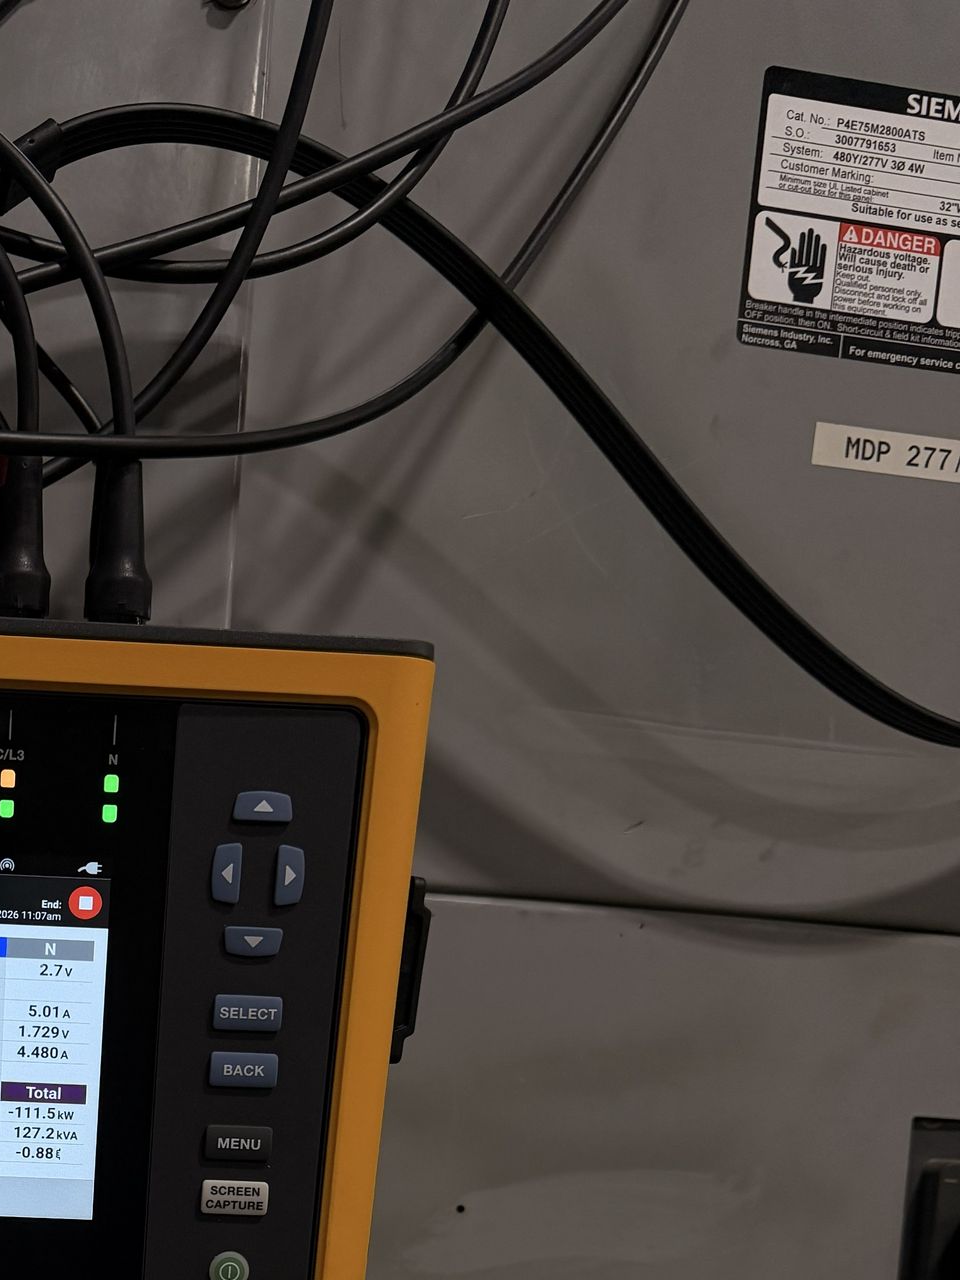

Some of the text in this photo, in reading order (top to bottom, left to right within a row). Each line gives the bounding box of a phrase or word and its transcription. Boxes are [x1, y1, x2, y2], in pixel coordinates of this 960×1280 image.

[786, 109, 807, 123] Cat.
[837, 118, 926, 141] P4E75M2800ATS
[835, 134, 896, 153] 3007791653
[783, 142, 823, 158] System:
[833, 151, 889, 168] 480Y/277V
[908, 162, 925, 174] 4W
[933, 150, 954, 162] Item
[781, 159, 874, 184] Customer Marking:
[851, 202, 948, 227] Suitable for use as
[862, 228, 936, 254] DANGER
[840, 243, 931, 266] Hazardous voltage.
[839, 252, 856, 263] Will
[859, 257, 887, 268] cause
[890, 261, 917, 272] death
[837, 262, 905, 281] serious injury.
[845, 436, 891, 462] MDP
[109, 754, 119, 766] N
[41, 900, 62, 909] End:
[21, 911, 61, 921] 11:07am
[45, 943, 56, 955] N
[219, 1007, 277, 1020] SELECT
[223, 1064, 264, 1077] BACK
[26, 1086, 61, 1100] Total
[217, 1137, 261, 1150] MENU
[210, 1185, 260, 1197] SCREEN
[205, 1199, 263, 1211] CAPTURE
